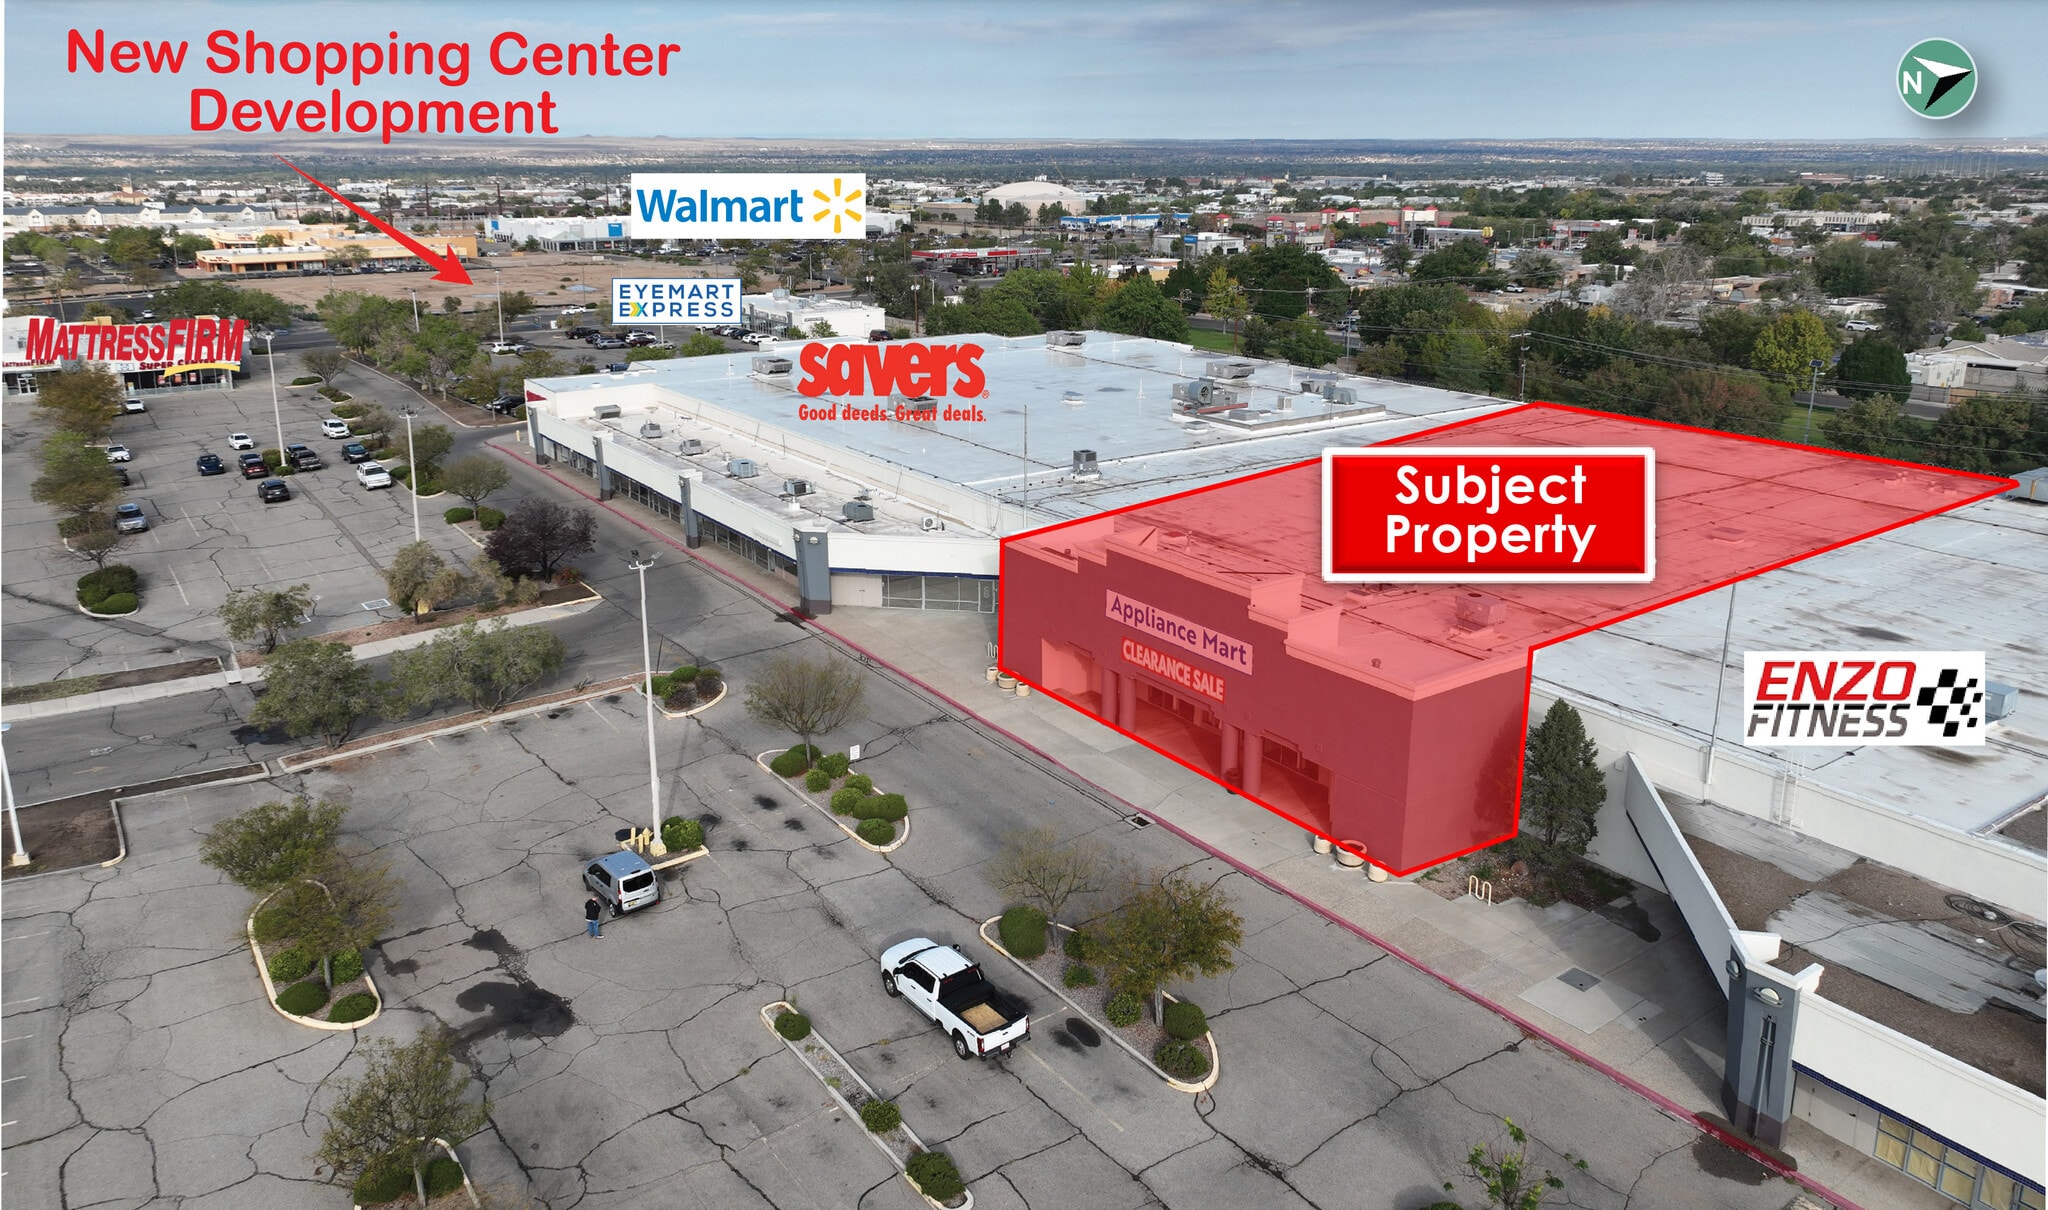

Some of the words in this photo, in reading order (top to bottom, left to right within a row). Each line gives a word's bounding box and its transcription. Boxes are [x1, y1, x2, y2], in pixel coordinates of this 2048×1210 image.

[1111, 595, 1197, 645] Appliance
[1203, 629, 1247, 665] Mart
[1122, 640, 1191, 687] CLEARANCE
[1192, 669, 1225, 701] SALE
